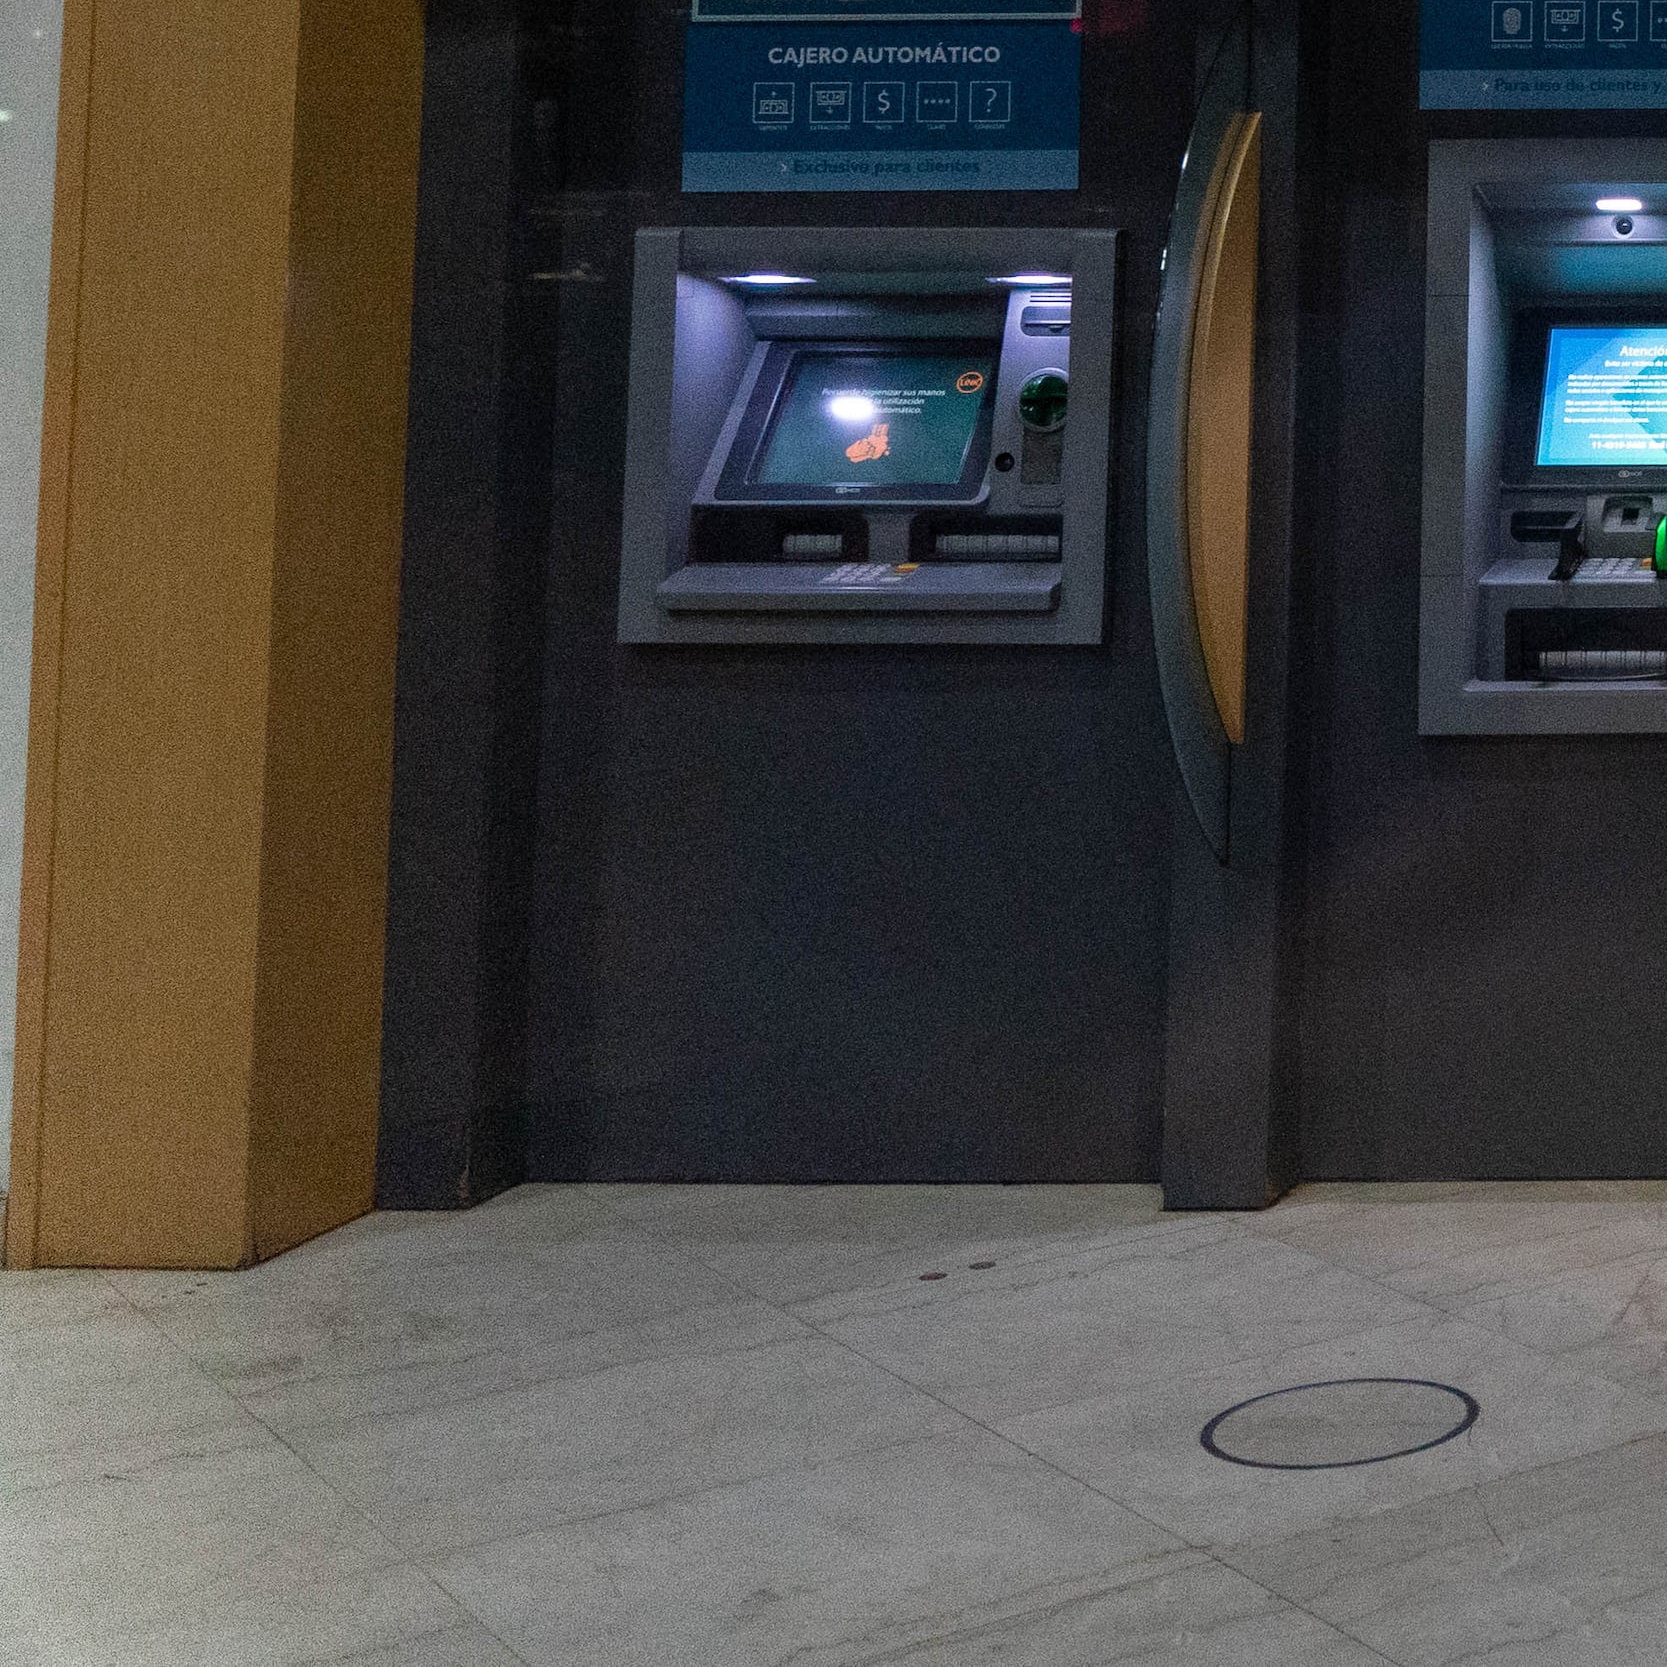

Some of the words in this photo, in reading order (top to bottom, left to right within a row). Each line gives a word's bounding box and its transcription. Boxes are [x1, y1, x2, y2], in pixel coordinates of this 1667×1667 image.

[768, 46, 848, 69] CAJERO
[852, 41, 1001, 64] AUTOMÁTICO
[1494, 78, 1530, 91] Para
[1534, 80, 1561, 91] uso
[1566, 78, 1585, 91] de
[1589, 77, 1648, 91] clientes
[793, 160, 870, 174] Exclusivo
[875, 163, 911, 177] para
[916, 159, 980, 173] clientes
[883, 397, 925, 405] utilización
